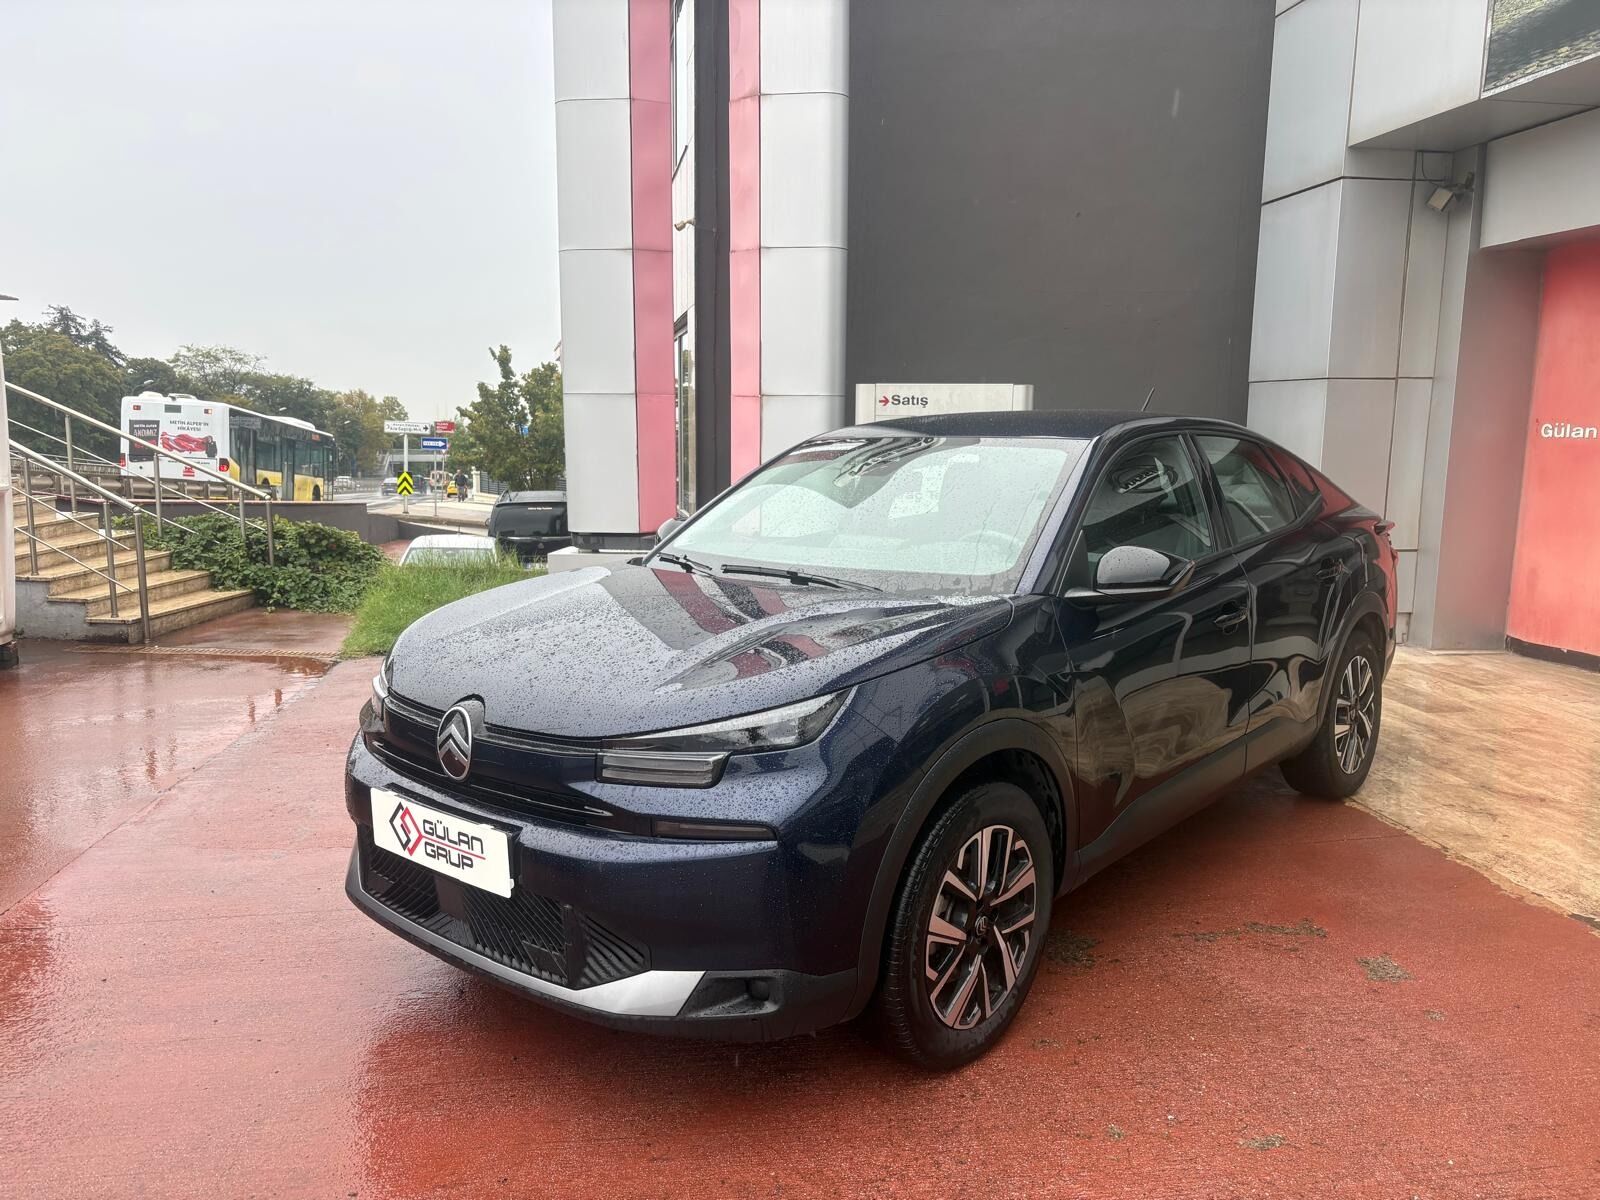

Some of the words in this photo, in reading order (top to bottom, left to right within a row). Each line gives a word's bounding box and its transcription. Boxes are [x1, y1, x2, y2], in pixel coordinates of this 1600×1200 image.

[891, 394, 929, 408] Satış
[1541, 422, 1598, 439] Gülan
[422, 819, 484, 854] GÜLAN
[424, 841, 474, 870] GRUP
